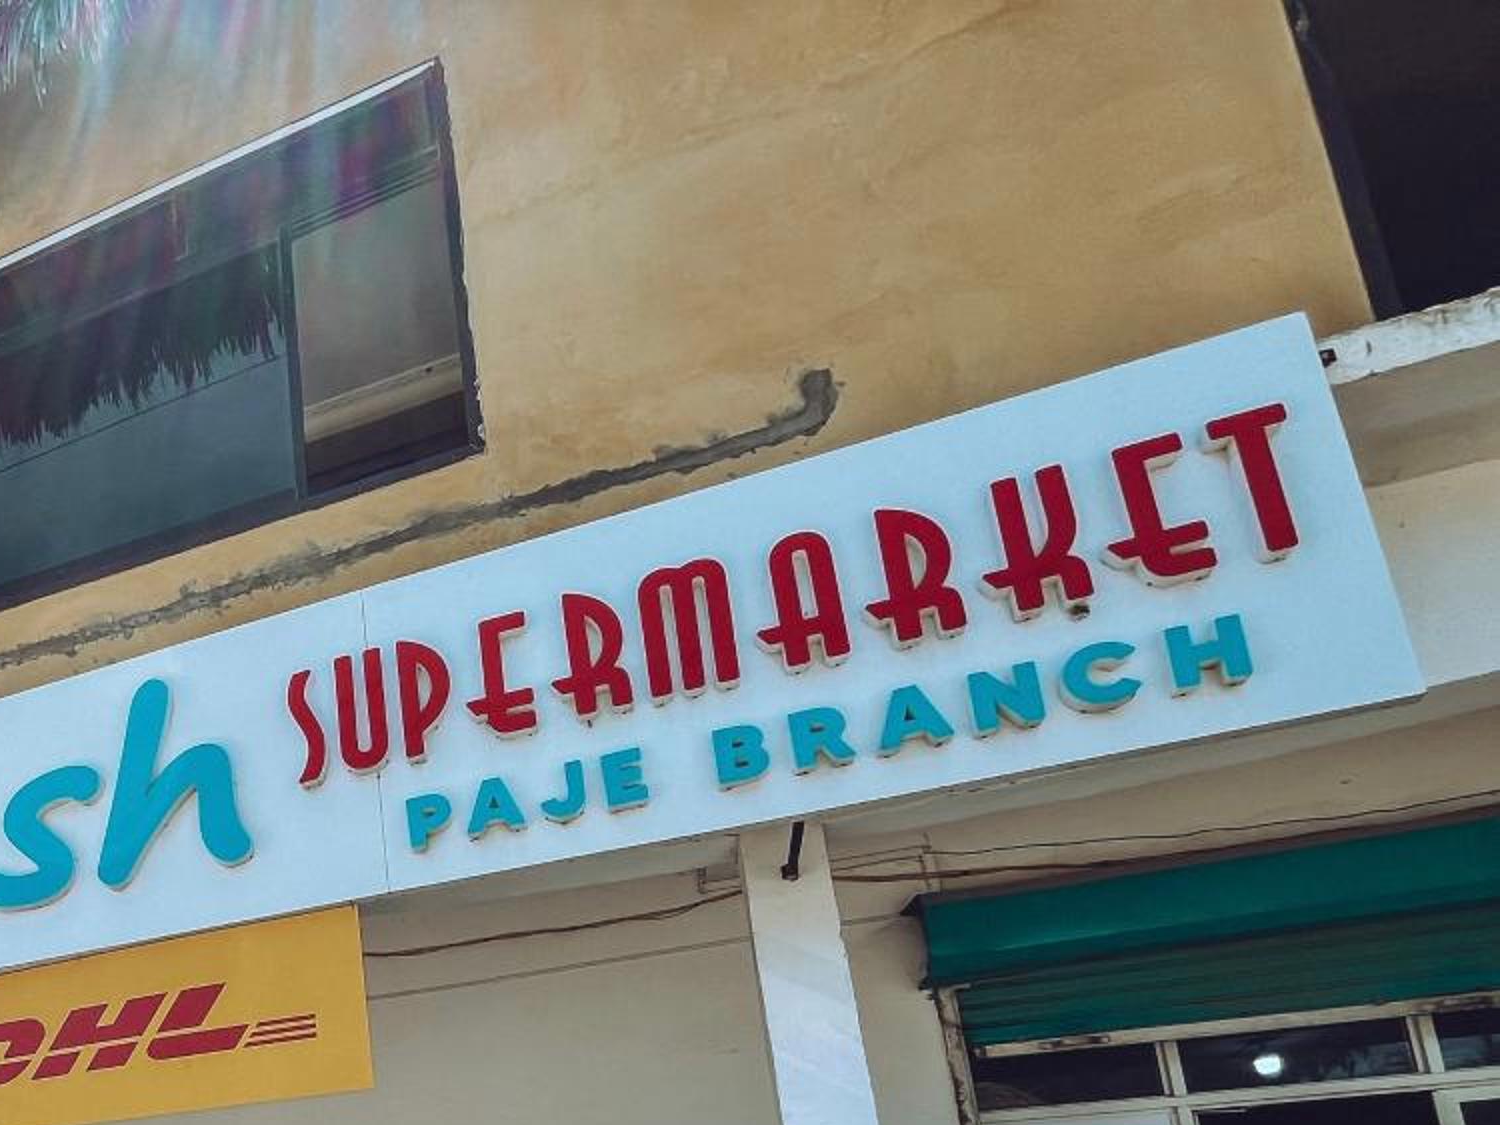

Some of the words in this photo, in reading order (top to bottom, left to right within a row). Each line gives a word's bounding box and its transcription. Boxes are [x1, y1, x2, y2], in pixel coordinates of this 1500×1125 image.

[287, 402, 1300, 786] SUPERMARKET
[405, 746, 651, 852] PAJE
[711, 613, 1256, 790] BRANCH
